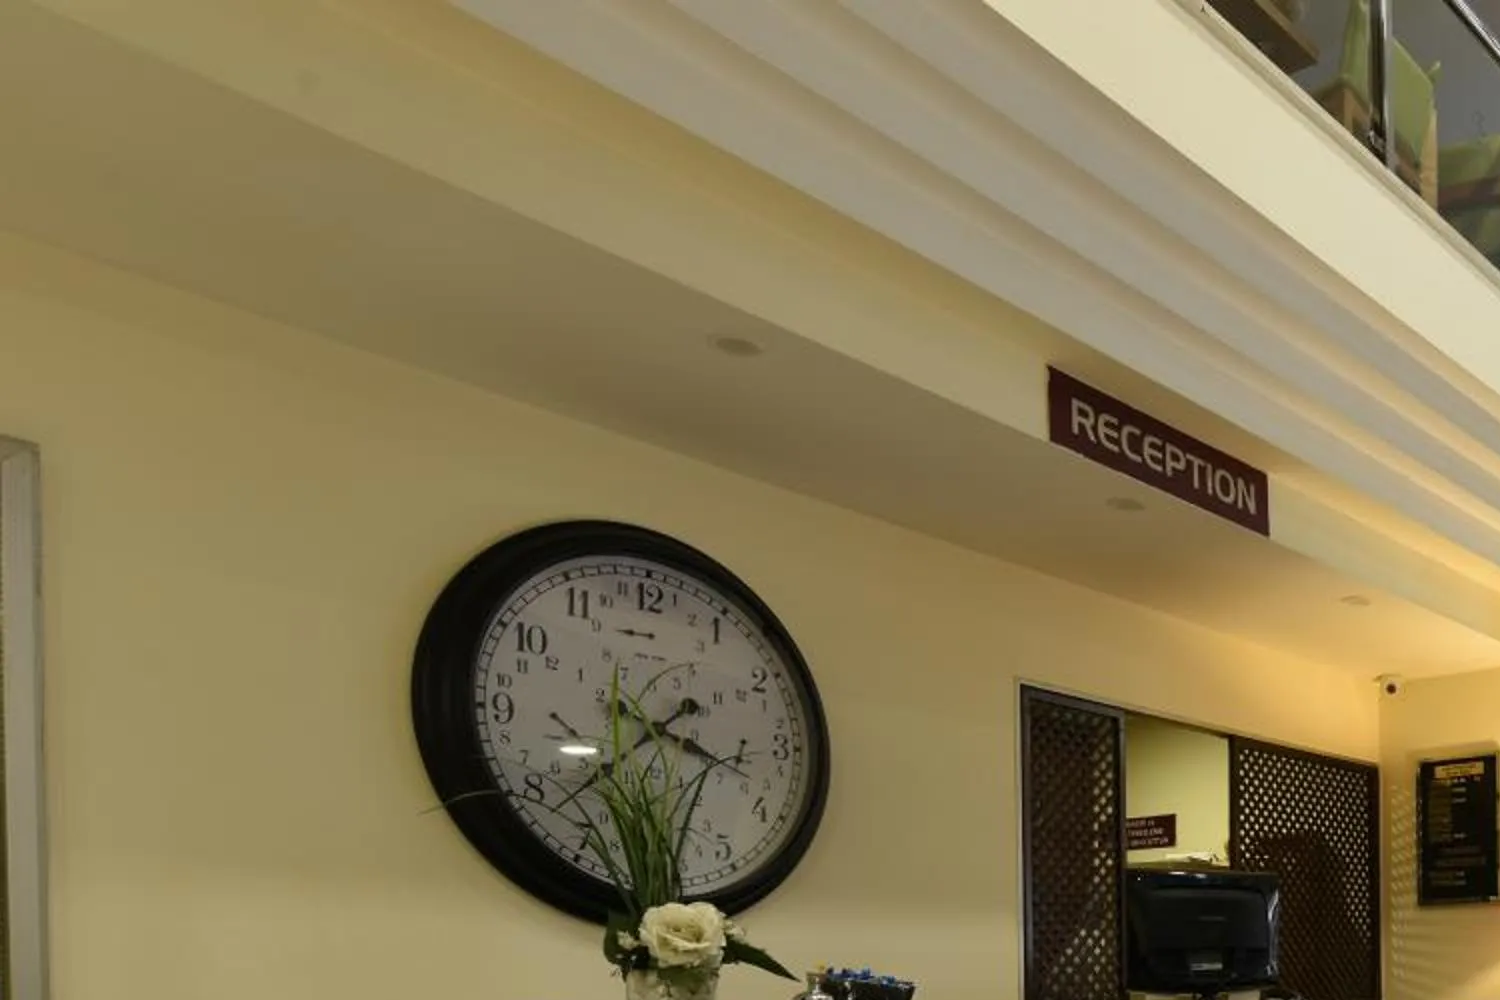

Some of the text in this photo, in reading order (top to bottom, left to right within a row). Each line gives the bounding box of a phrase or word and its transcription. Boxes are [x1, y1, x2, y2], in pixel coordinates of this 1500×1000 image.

[1070, 397, 1257, 515] RECEPTION
[567, 586, 589, 619] 11
[637, 582, 664, 614] 12
[515, 621, 548, 655] 10
[712, 616, 720, 645] 1
[751, 665, 768, 694] 2
[491, 691, 515, 725] 9
[772, 733, 790, 761] 3
[524, 772, 546, 803] 8
[751, 796, 767, 823] 4
[716, 832, 733, 861] 5
